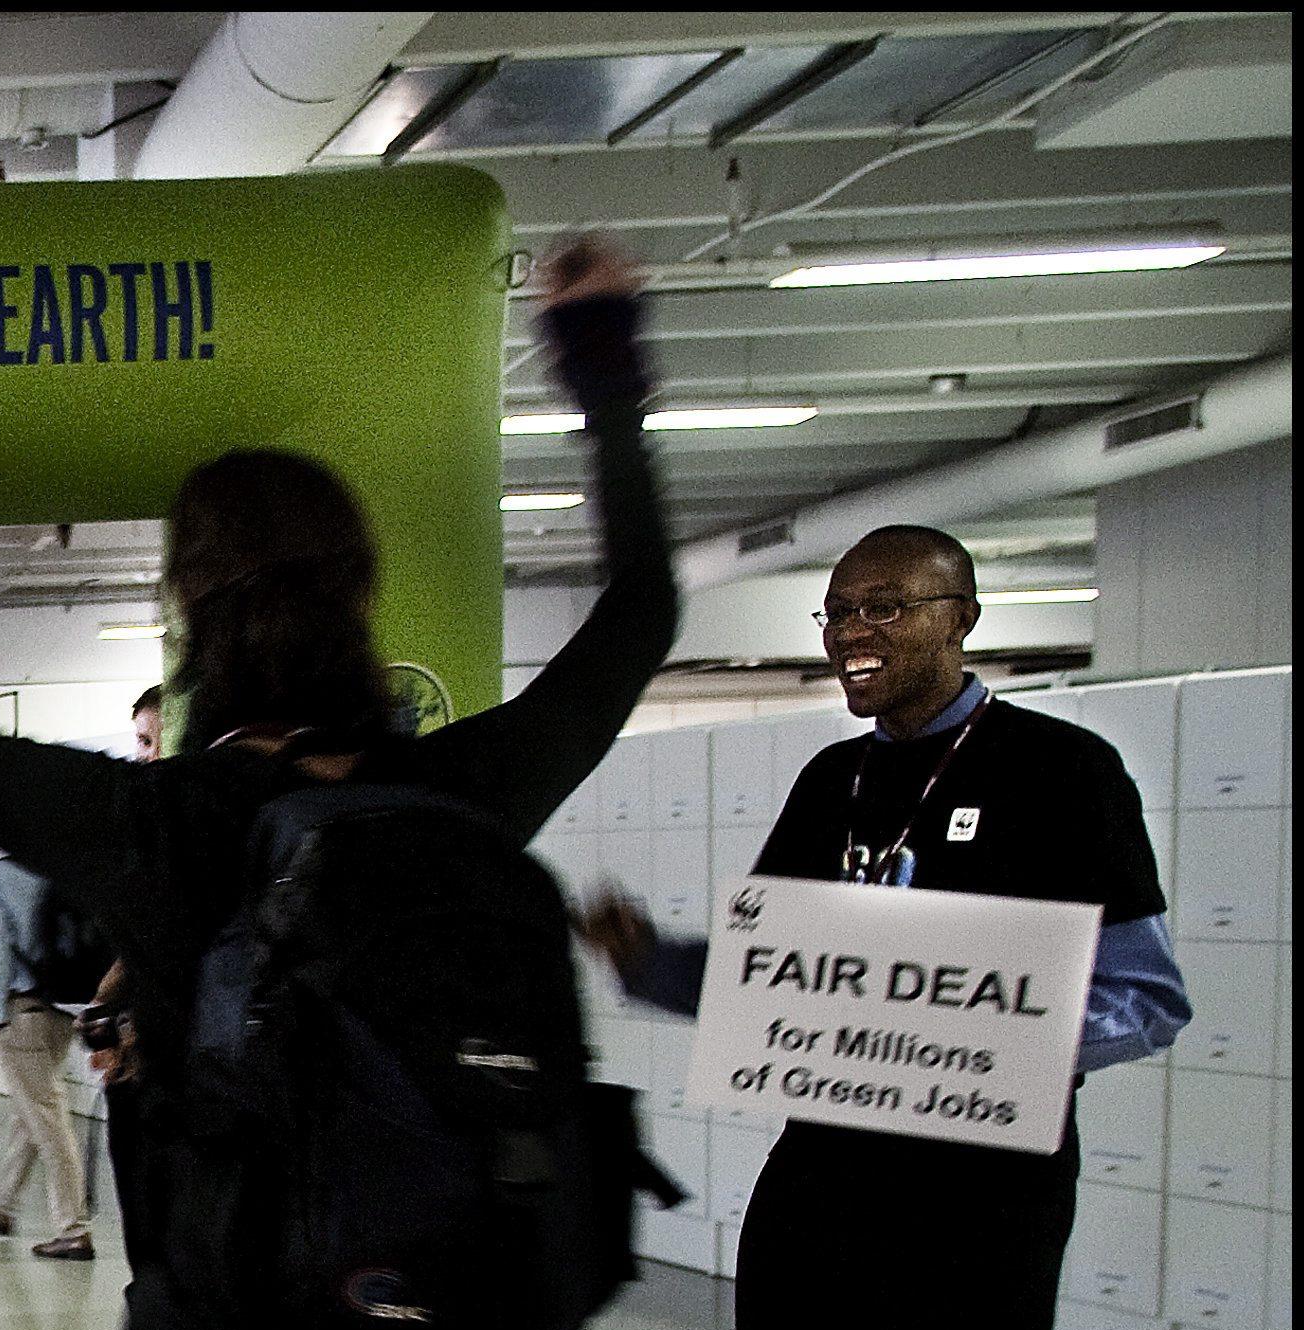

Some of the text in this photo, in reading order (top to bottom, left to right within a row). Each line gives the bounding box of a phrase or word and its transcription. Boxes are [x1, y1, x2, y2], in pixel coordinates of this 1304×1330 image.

[739, 944, 1048, 1017] FAIR DEAL
[765, 1017, 995, 1075] for Millions
[730, 1061, 1019, 1126] of Green Jobs
